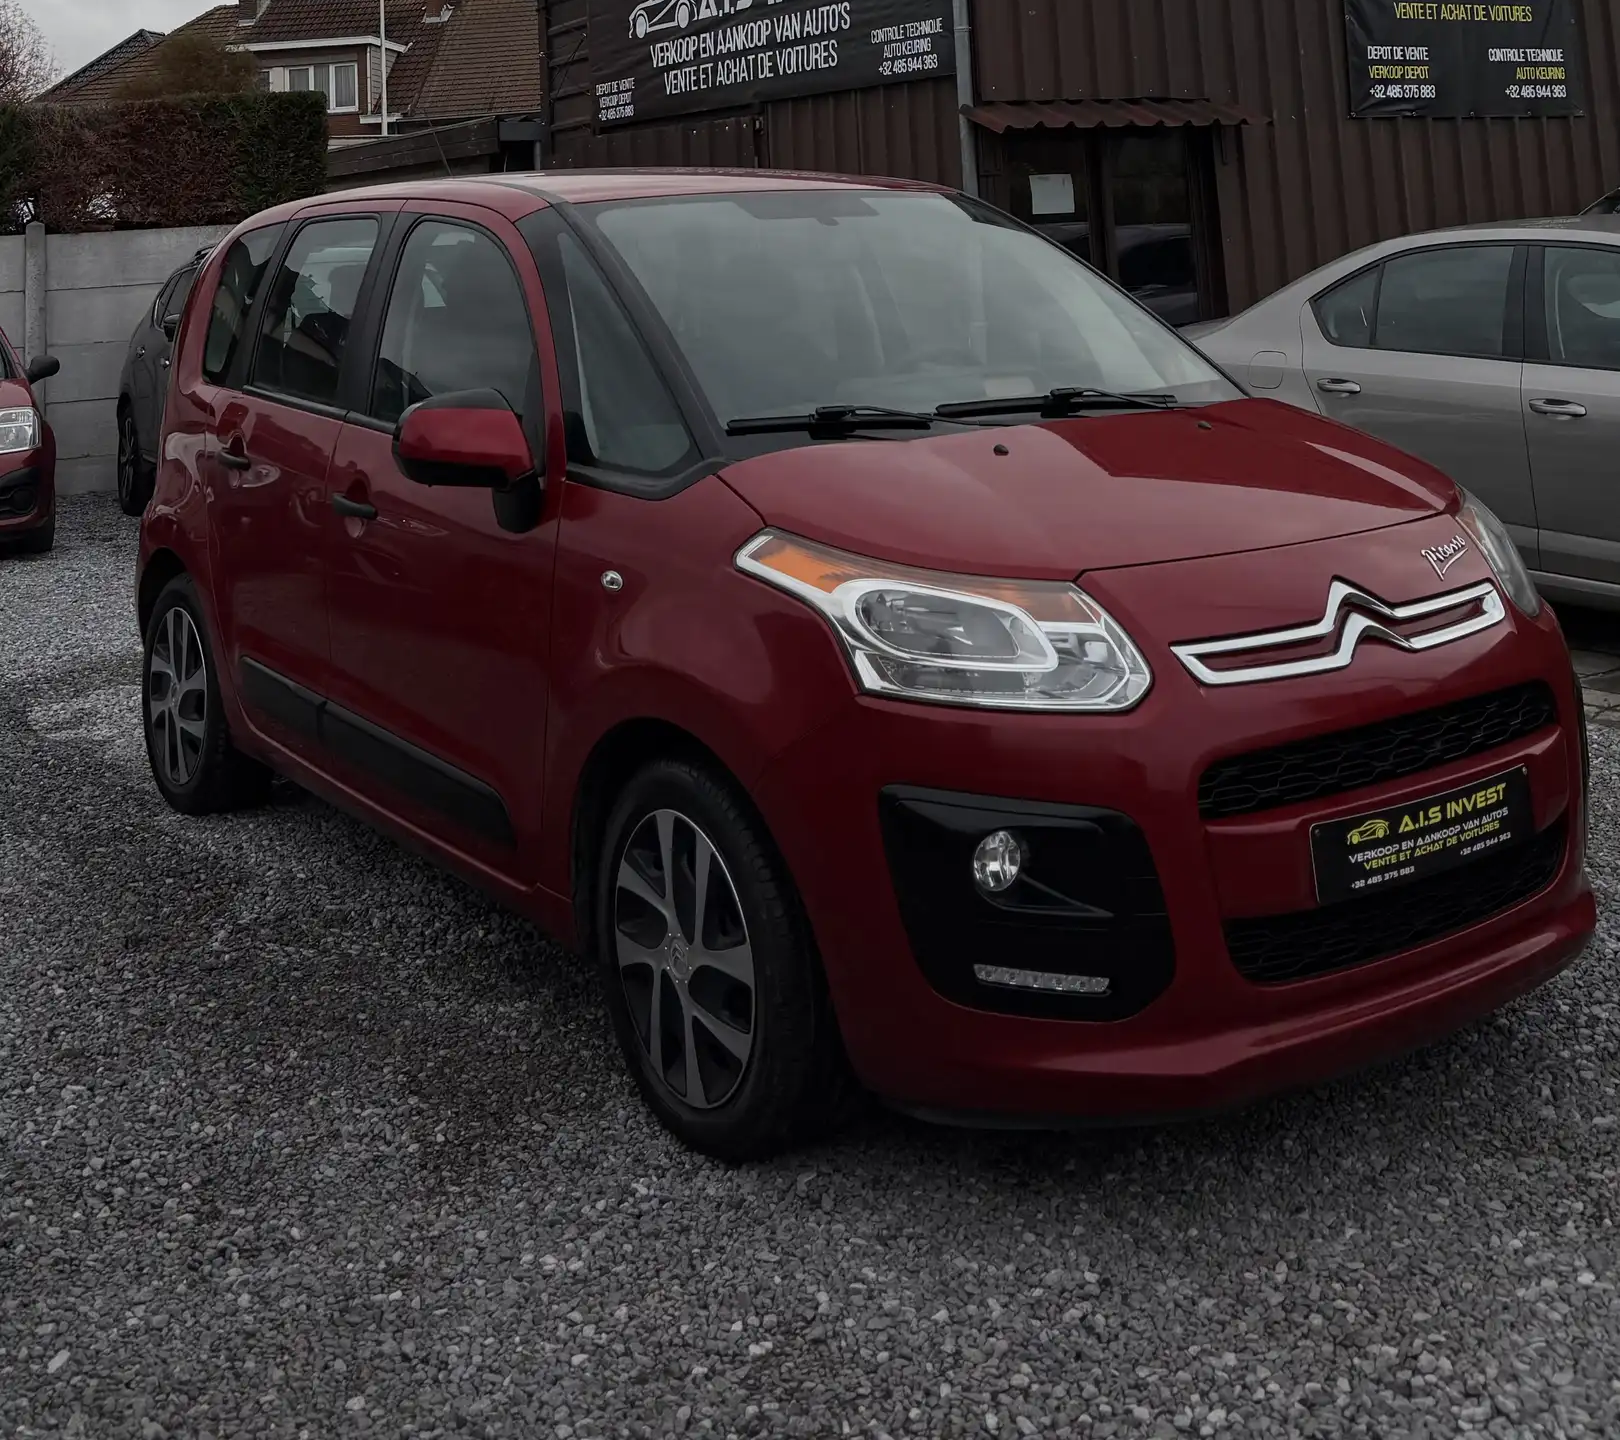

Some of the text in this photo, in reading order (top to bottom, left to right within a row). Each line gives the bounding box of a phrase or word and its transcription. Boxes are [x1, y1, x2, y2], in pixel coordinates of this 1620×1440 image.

[1394, 2, 1532, 22] VENTE ET ACHAT DE VOITURES
[650, 1, 850, 68] VERKOOP EN AANKOOP VAN AUTO'S
[870, 17, 943, 44] CONTROLE TECHNIQUE
[883, 37, 932, 59] AUTO KEURING
[1367, 45, 1429, 60] DEPOT DE VENTE
[1488, 48, 1564, 62] CONTROLE TECHNIQUE
[664, 39, 838, 95] VENTE ET ACHAT DE VOITURES
[878, 53, 938, 76] +32 485 944 363
[1368, 65, 1429, 79] VERKOOP DEPOT
[1516, 66, 1565, 80] AUTO KEURING
[595, 77, 635, 96] DEPOT DE VENTE
[1369, 84, 1436, 98] +32 485 375 883
[1505, 84, 1567, 98] +32 485 944 363
[599, 91, 632, 108] VERKOOP DEPOT
[1420, 535, 1469, 581] Picasso
[1398, 782, 1507, 835] A.I.S INVEST
[1349, 844, 1400, 864] VERKOOP
[1401, 839, 1414, 850] EN
[1416, 824, 1461, 847] AANKOOP
[1462, 817, 1480, 830] VAN
[1363, 820, 1500, 871] VENTE ET ACHAT DE VOITURES
